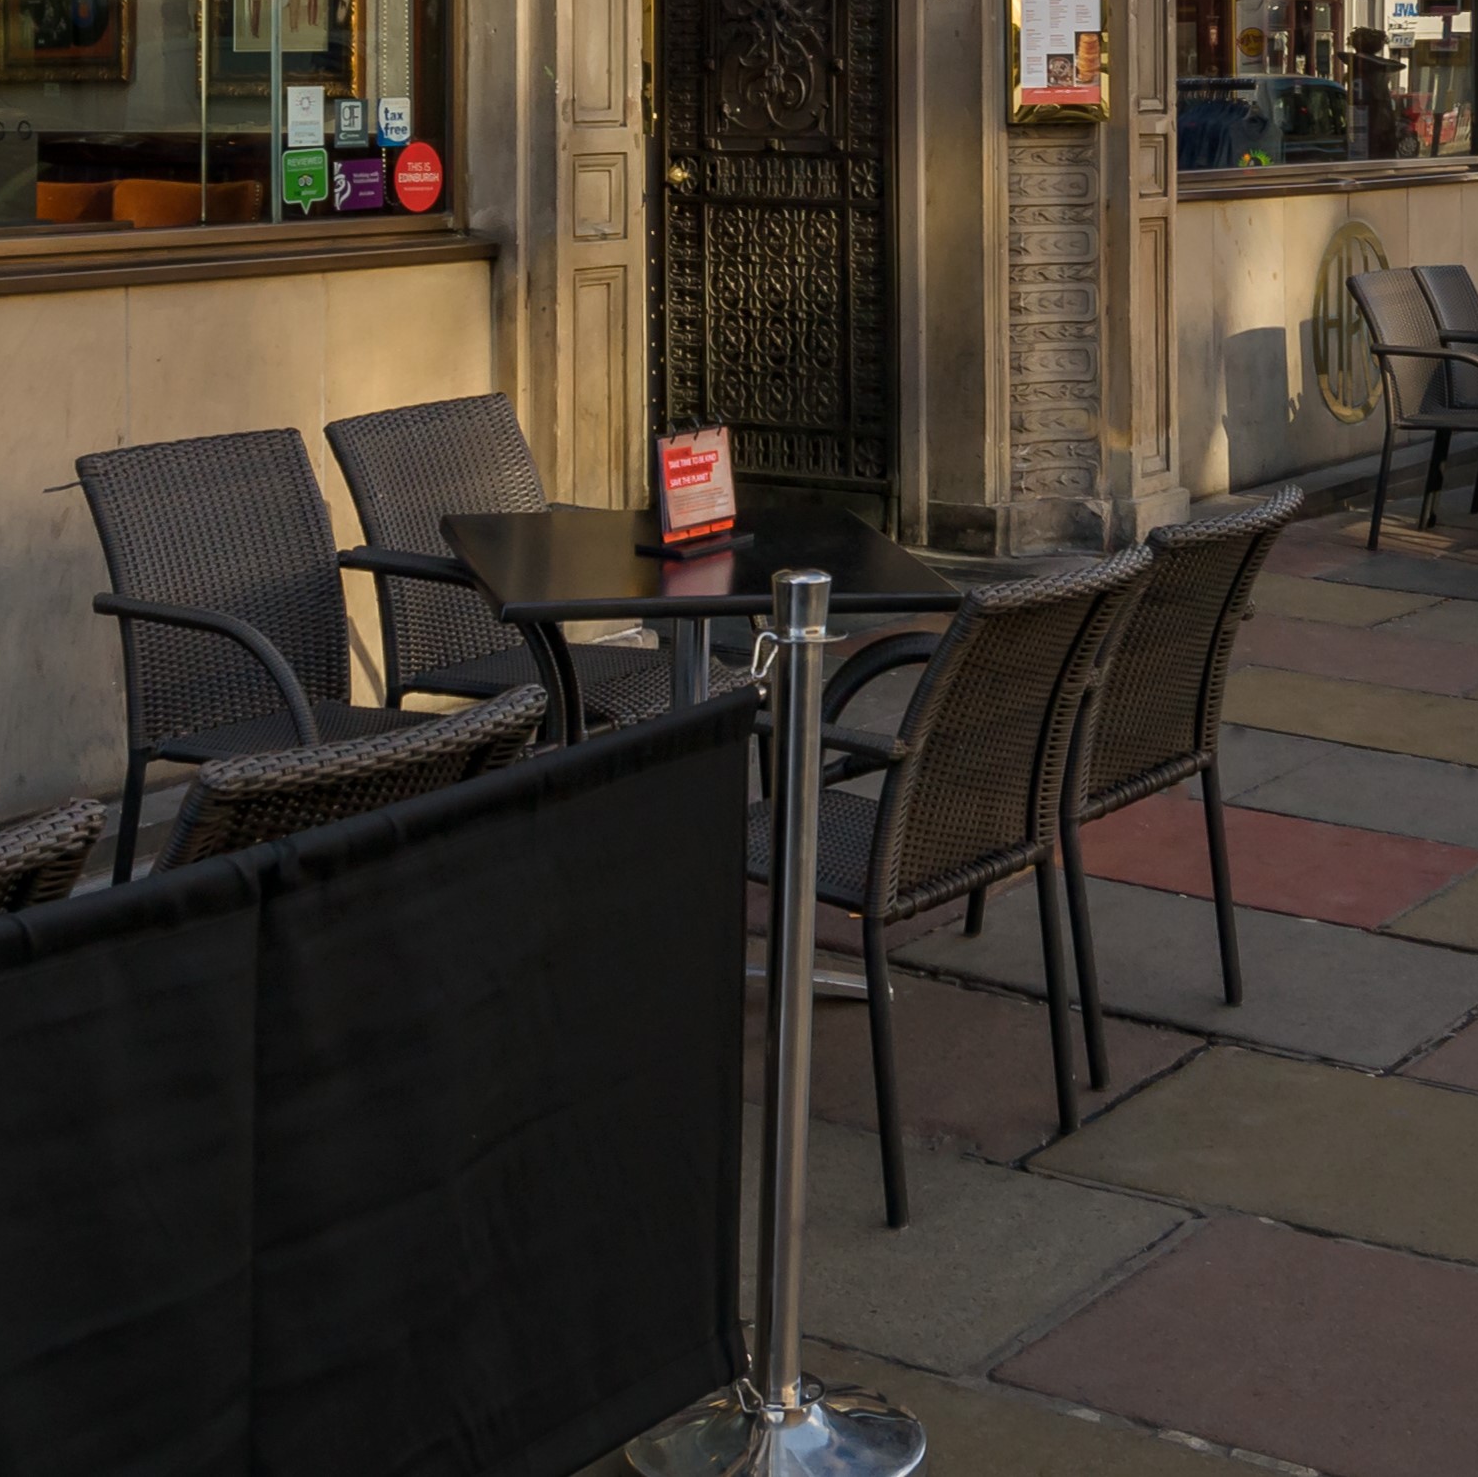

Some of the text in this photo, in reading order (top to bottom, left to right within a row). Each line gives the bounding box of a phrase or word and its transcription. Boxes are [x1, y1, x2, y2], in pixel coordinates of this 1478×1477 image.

[383, 107, 403, 121] tax
[383, 122, 409, 138] free
[287, 156, 323, 167] REVIEWED
[407, 162, 431, 172] THIS IS
[398, 172, 440, 184] EDINBURGH
